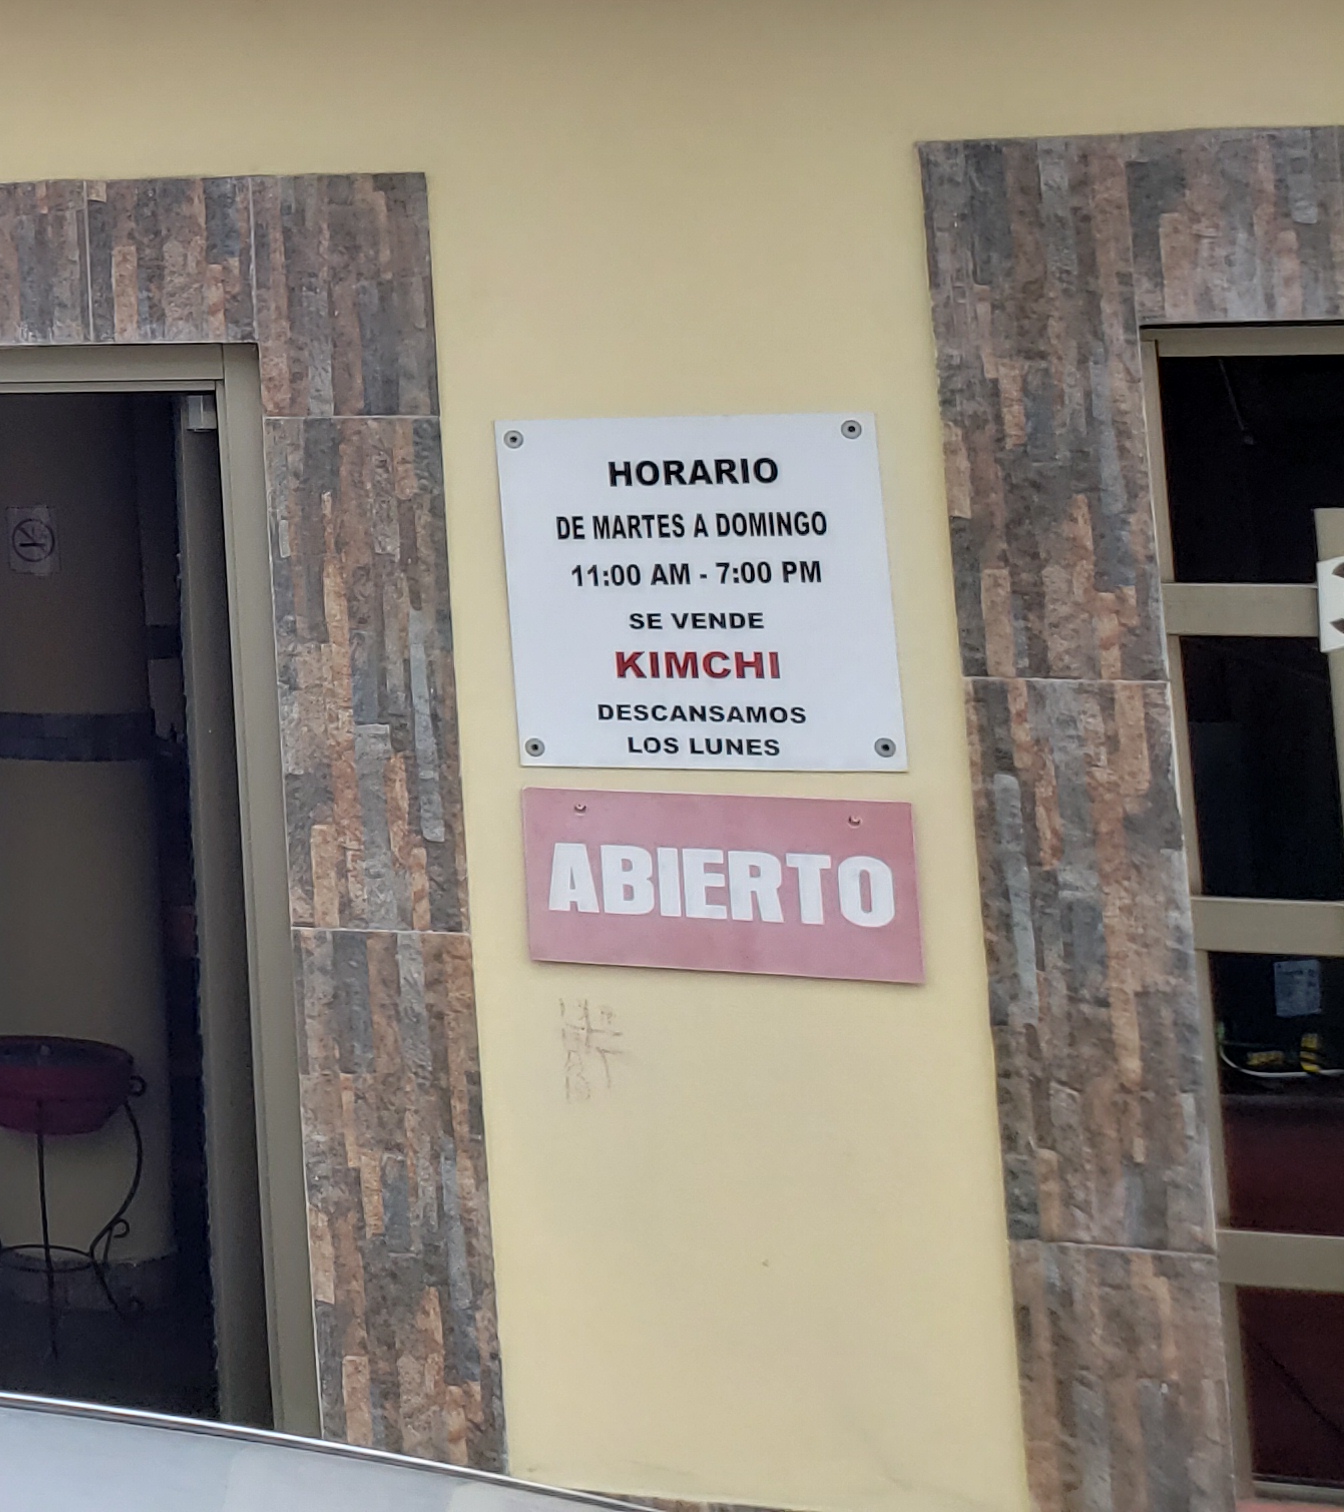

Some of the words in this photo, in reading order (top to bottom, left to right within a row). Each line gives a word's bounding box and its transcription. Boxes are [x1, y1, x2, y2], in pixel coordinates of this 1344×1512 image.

[608, 457, 779, 487] HORARIO
[556, 515, 585, 540] DE
[592, 513, 685, 540] MARTES
[693, 513, 709, 538] A
[716, 510, 828, 537] DOMINGO
[571, 564, 642, 587] 11:00
[650, 563, 691, 585] AM
[715, 561, 772, 584] 7:00
[782, 560, 823, 583] PM
[628, 612, 663, 630] SE
[671, 611, 765, 630] VENDE
[614, 650, 781, 679] KIMCHI
[597, 703, 807, 724] DESCANSAMOS
[627, 736, 680, 755] LOS
[689, 737, 781, 757] LUNES
[548, 842, 896, 928] ABIERTO
